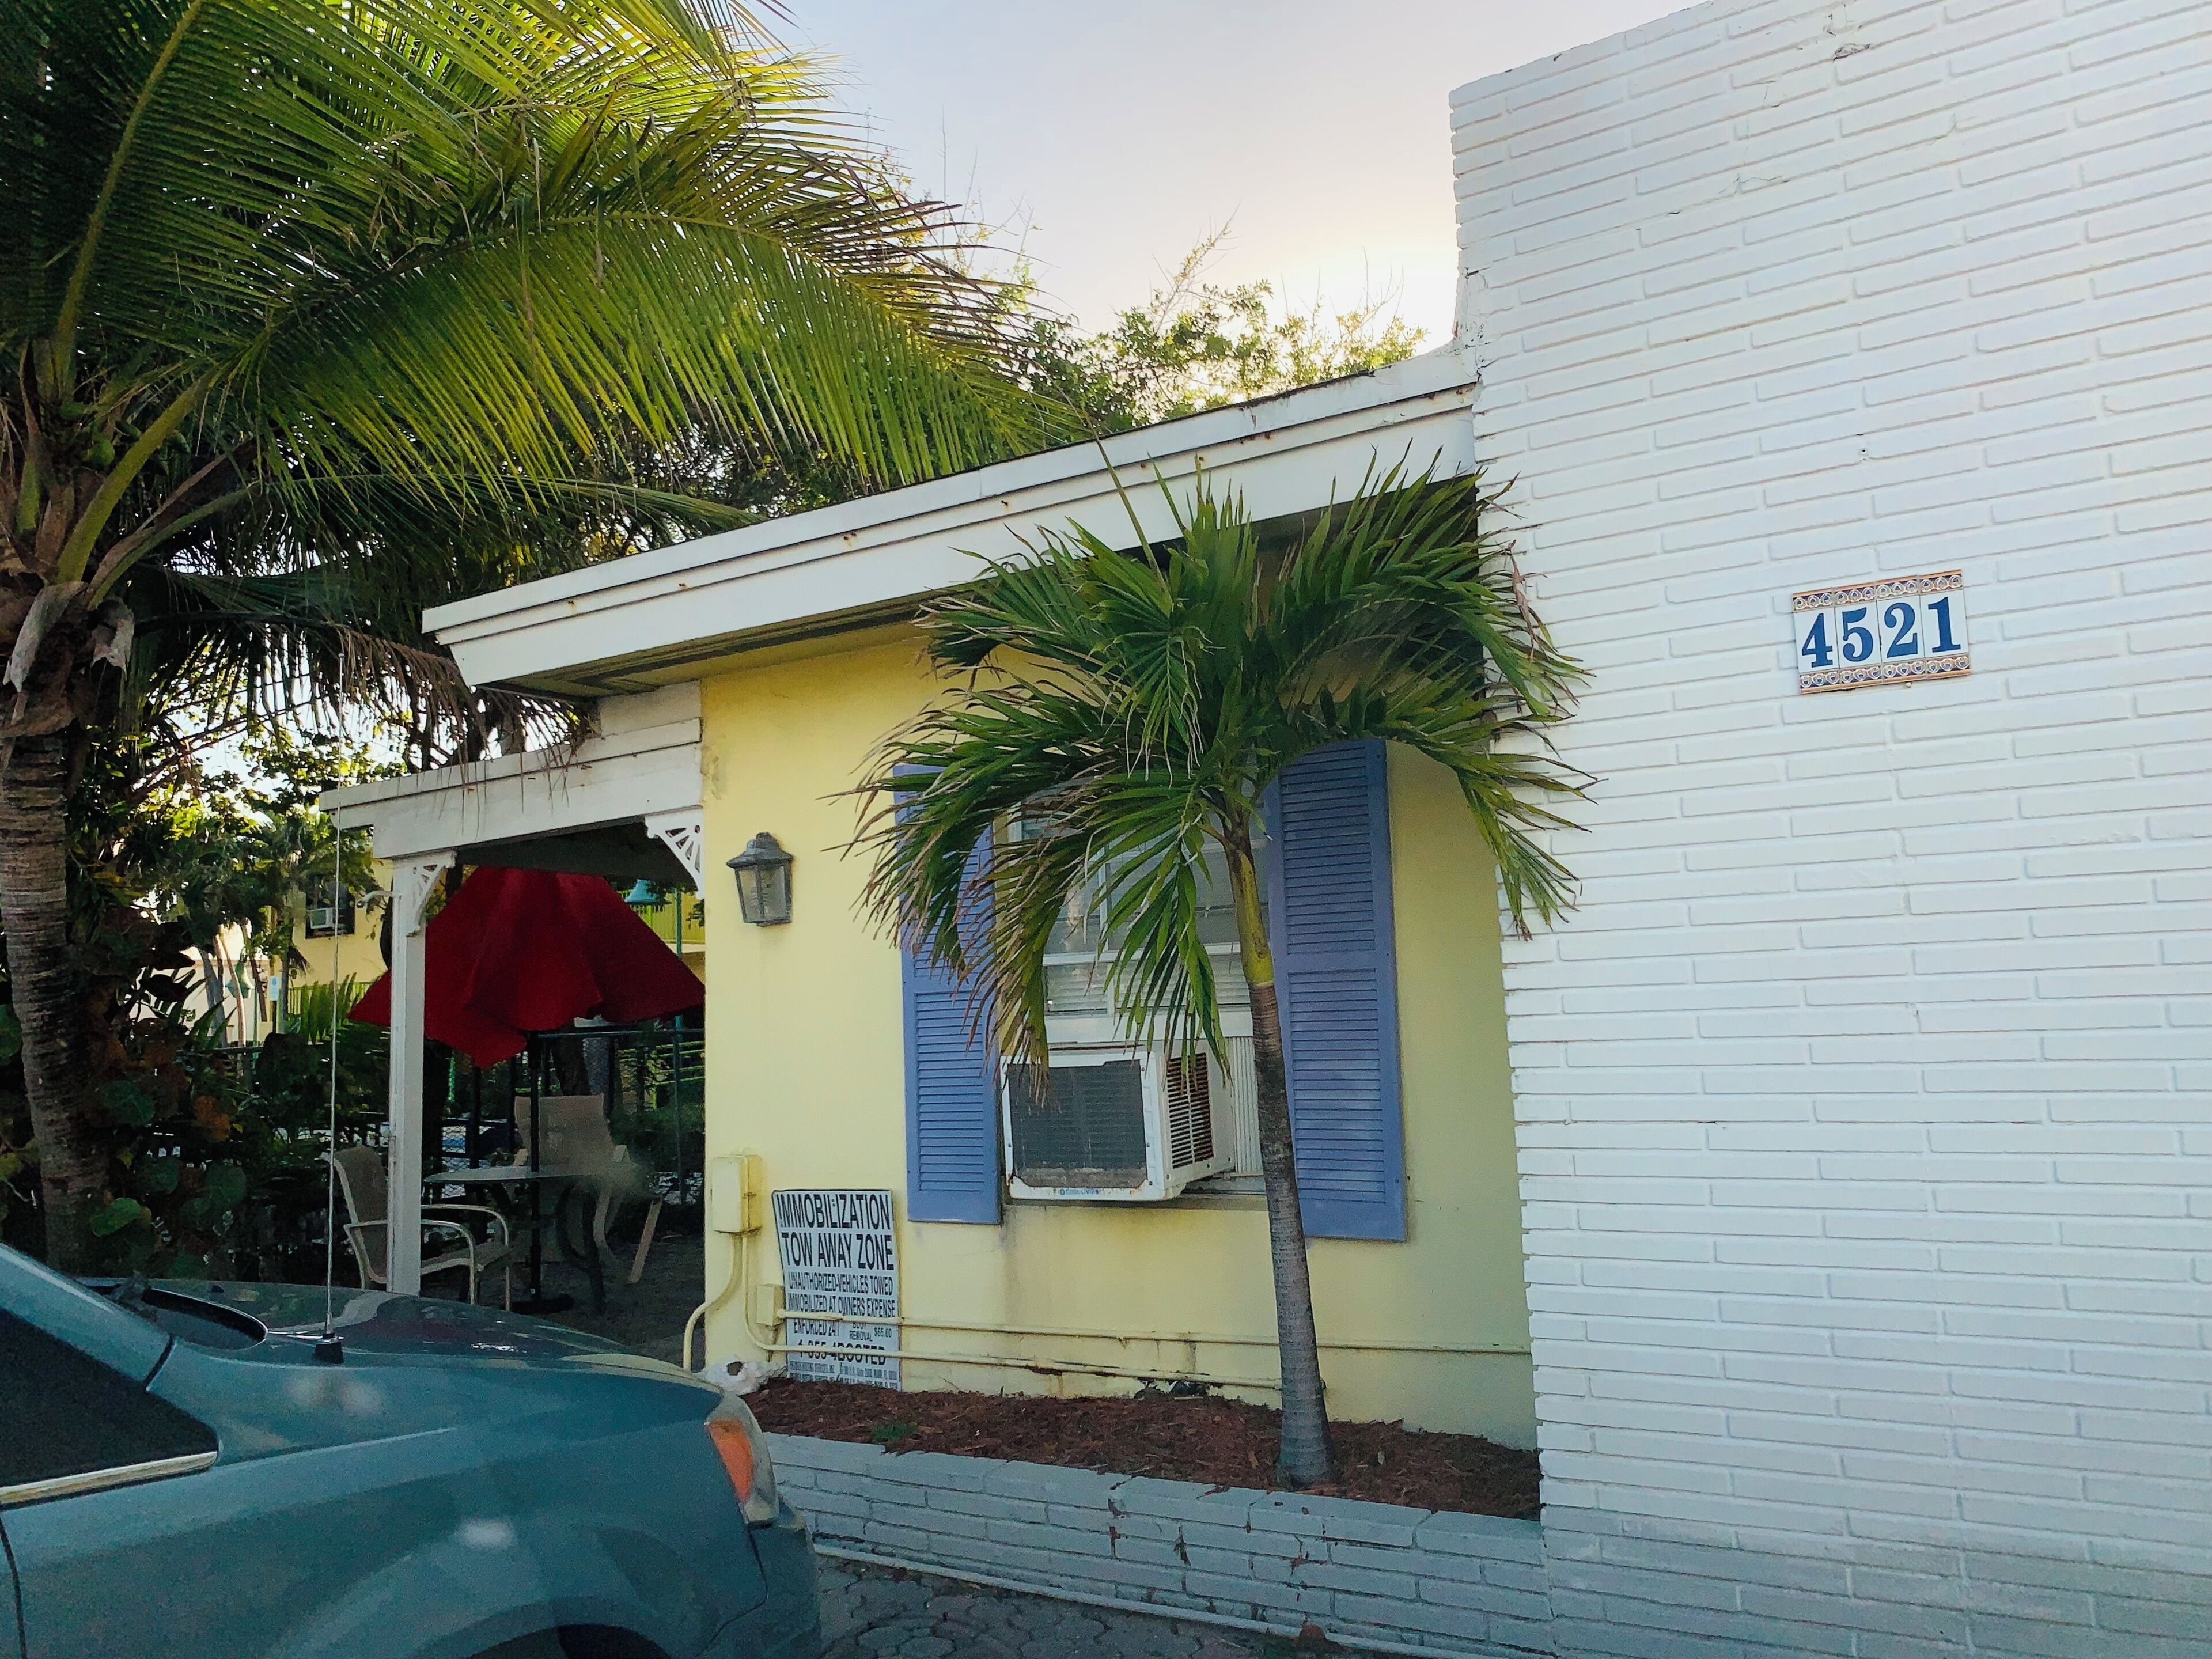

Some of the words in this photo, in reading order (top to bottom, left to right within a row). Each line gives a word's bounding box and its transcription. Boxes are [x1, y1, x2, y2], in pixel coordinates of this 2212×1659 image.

[1801, 596, 1961, 668] 4521
[777, 1194, 891, 1230] IMMOBILIZATION
[782, 1232, 813, 1267] TOW
[818, 1233, 852, 1268] AWAY
[857, 1234, 894, 1271] ZONE
[870, 1275, 893, 1296] TOWED
[788, 1293, 827, 1312] IMMOBILIZED
[830, 1296, 836, 1313] AT
[838, 1297, 865, 1316] OWNERS
[867, 1298, 895, 1318] EXPENSE
[794, 1318, 827, 1335] ENFORCED
[849, 1331, 873, 1342] REMOVAL
